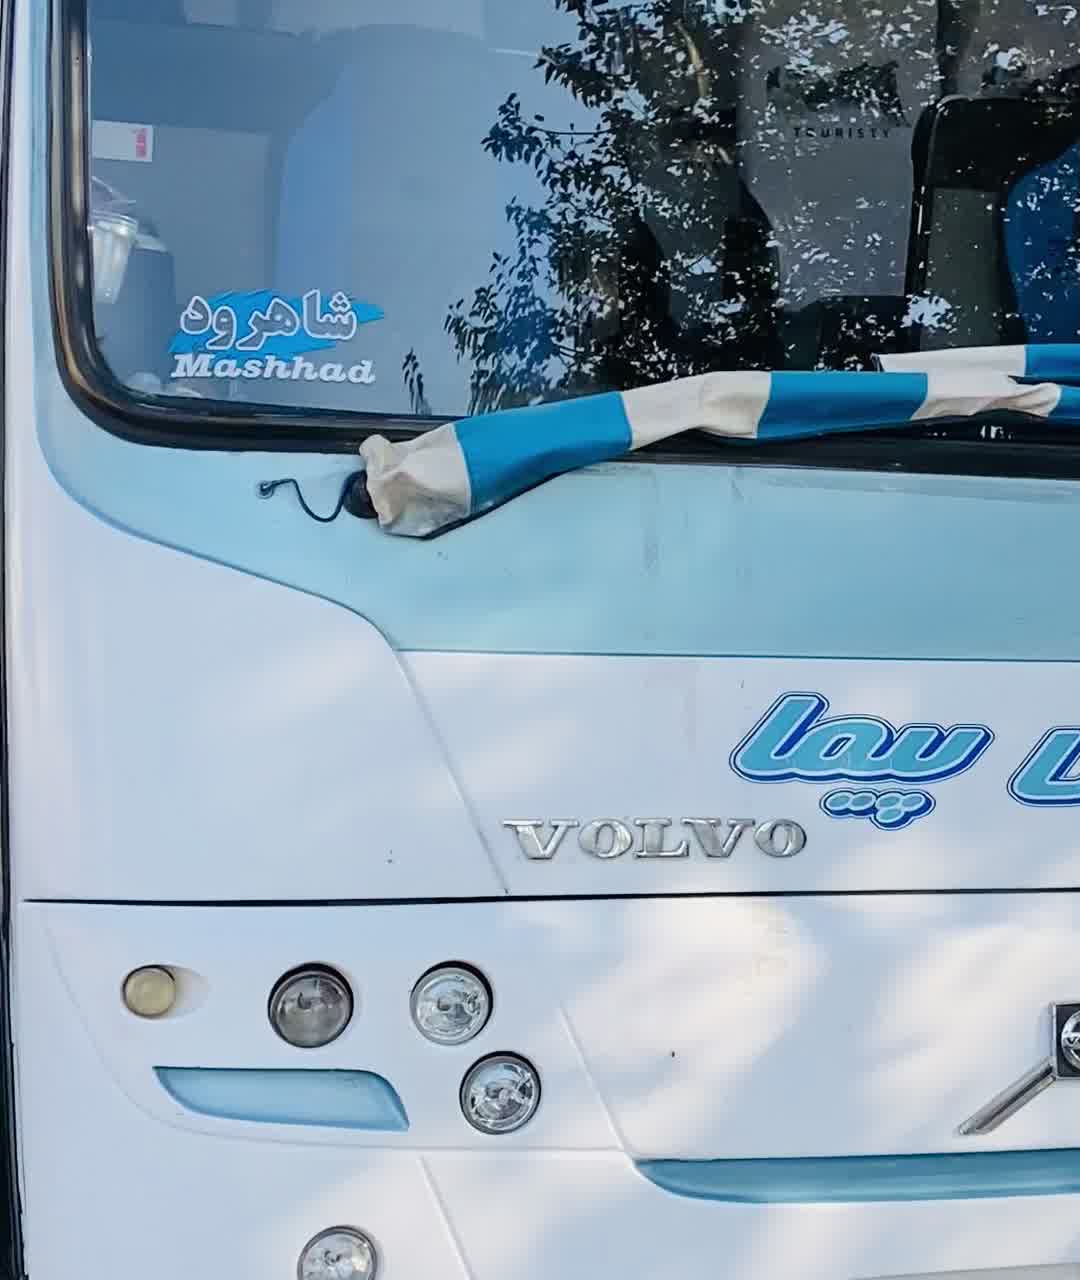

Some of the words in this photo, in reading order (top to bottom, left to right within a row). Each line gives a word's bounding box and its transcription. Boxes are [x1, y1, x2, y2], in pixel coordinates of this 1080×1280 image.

[180, 288, 358, 351] شاهرود
[170, 352, 377, 384] Mashhad
[728, 691, 997, 831] پیما
[502, 816, 808, 861] VOLVO
